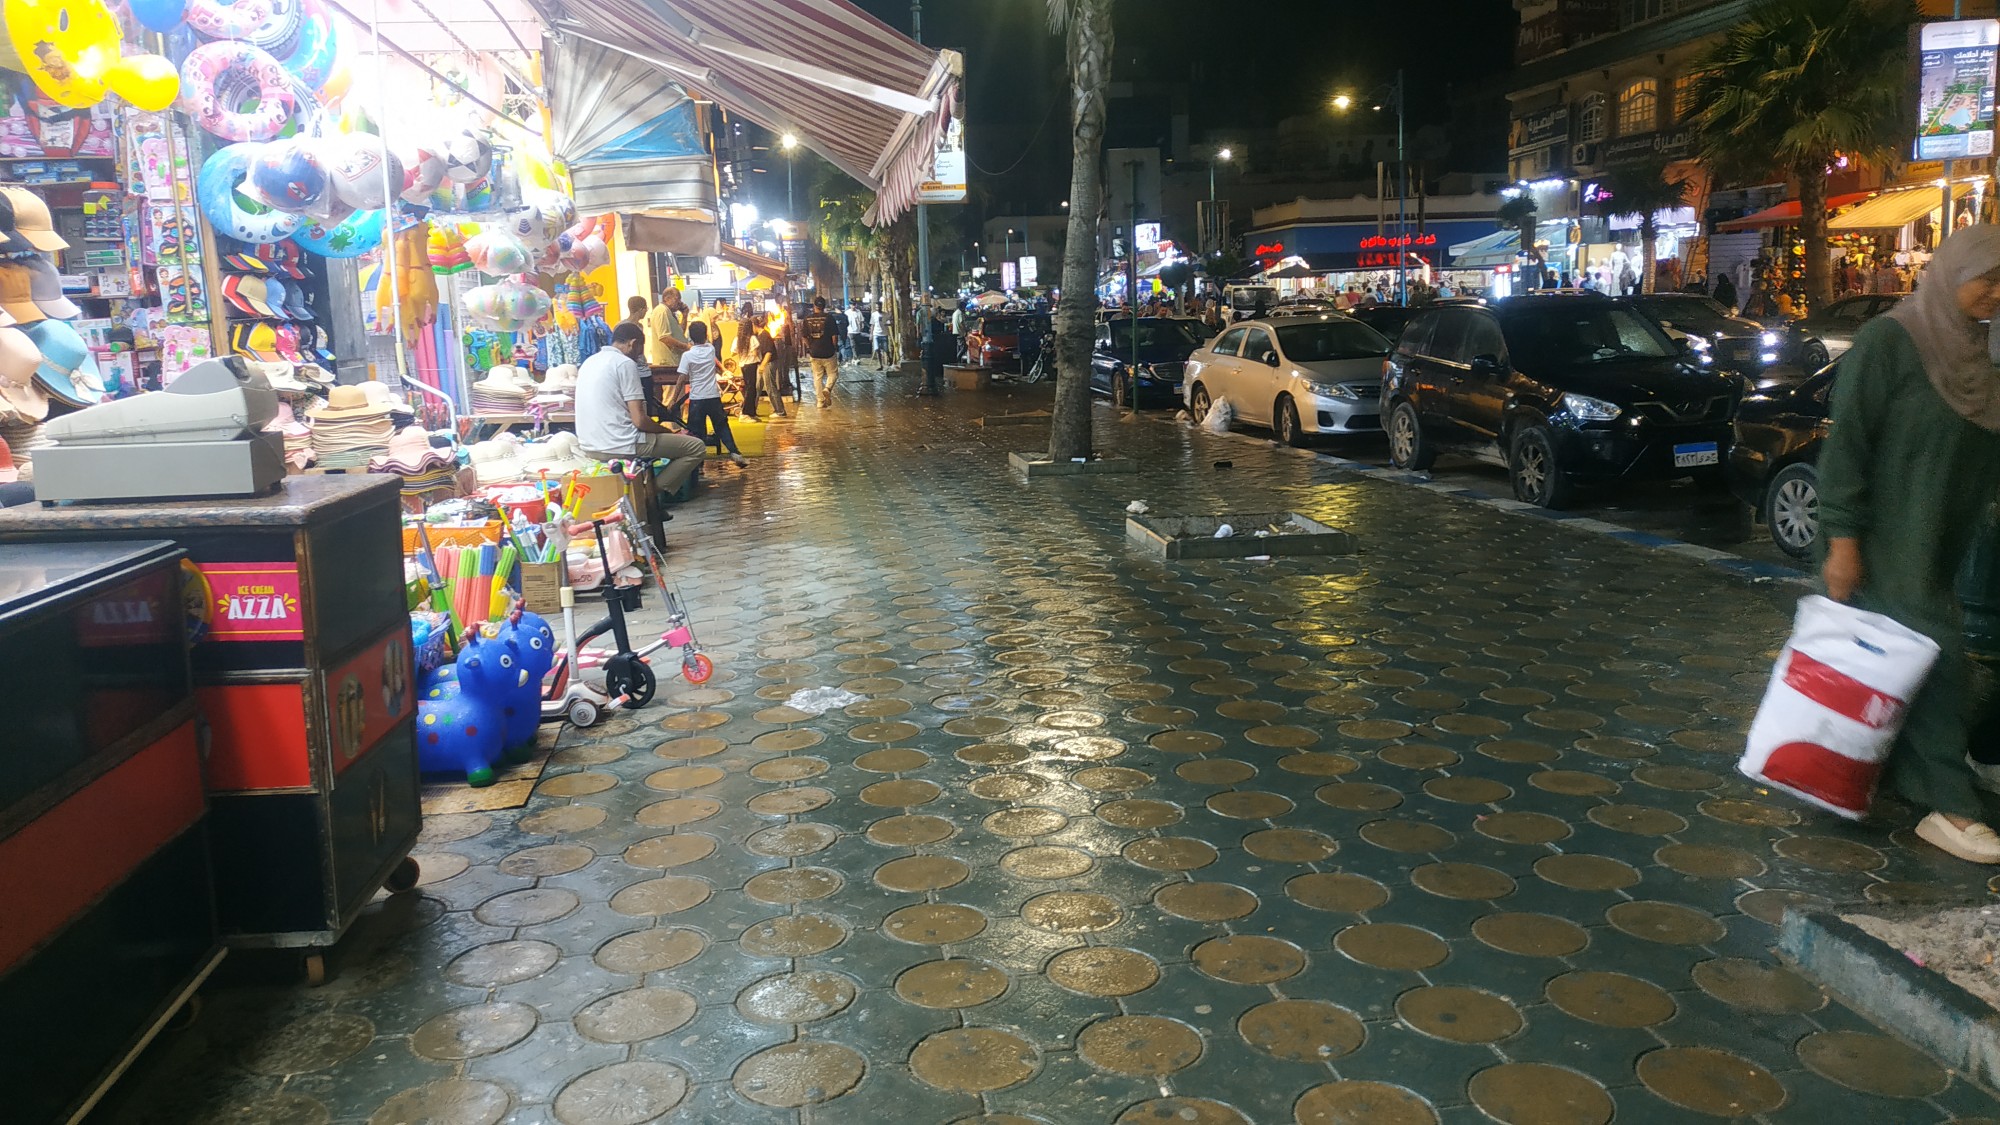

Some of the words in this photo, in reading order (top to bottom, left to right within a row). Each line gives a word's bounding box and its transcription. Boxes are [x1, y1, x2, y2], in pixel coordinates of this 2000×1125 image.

[237, 585, 250, 595] ICE
[250, 585, 275, 595] CREAM
[227, 594, 287, 620] AZZA
